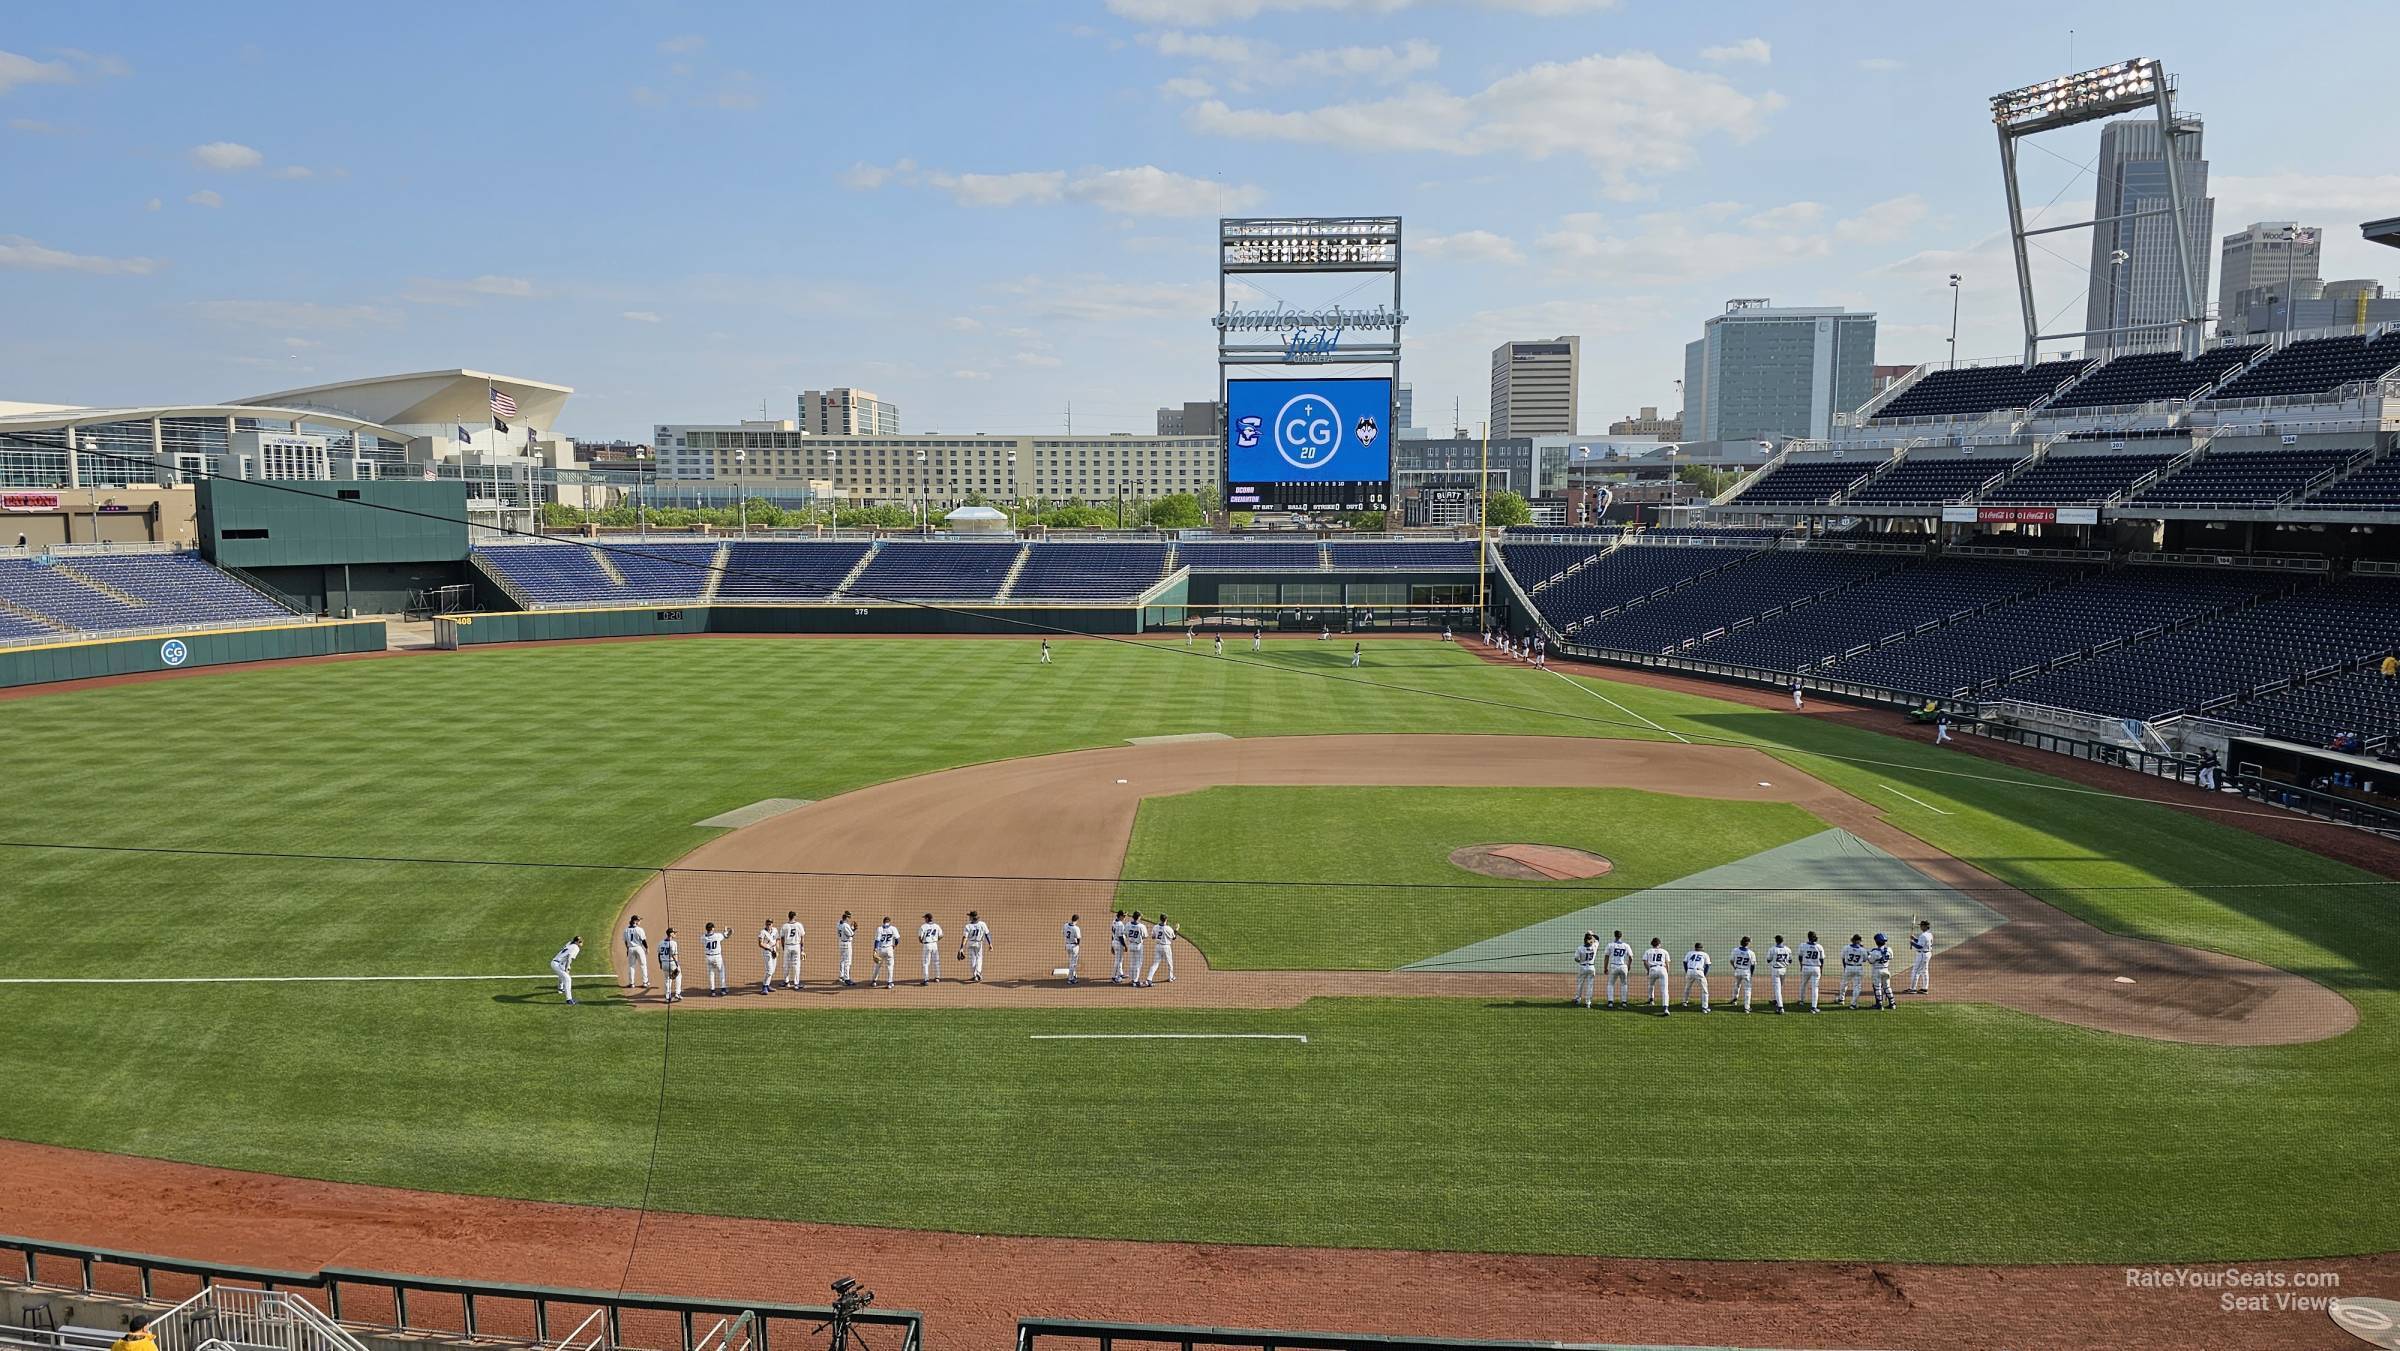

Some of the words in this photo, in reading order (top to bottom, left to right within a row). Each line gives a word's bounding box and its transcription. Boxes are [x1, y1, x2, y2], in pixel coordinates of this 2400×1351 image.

[1286, 418, 1331, 445] CG
[1300, 447, 1317, 459] 20
[1436, 491, 1462, 500] BLATT
[457, 617, 472, 625] 408
[165, 647, 183, 658] CG
[925, 929, 937, 938] 24
[1128, 929, 1140, 939] 28
[705, 941, 717, 950] 40
[1613, 948, 1626, 958] 50
[1652, 953, 1663, 962] 18
[1689, 954, 1703, 962] 45
[1805, 950, 1819, 960] 38
[1847, 953, 1861, 963] 33
[1736, 956, 1749, 966] 22
